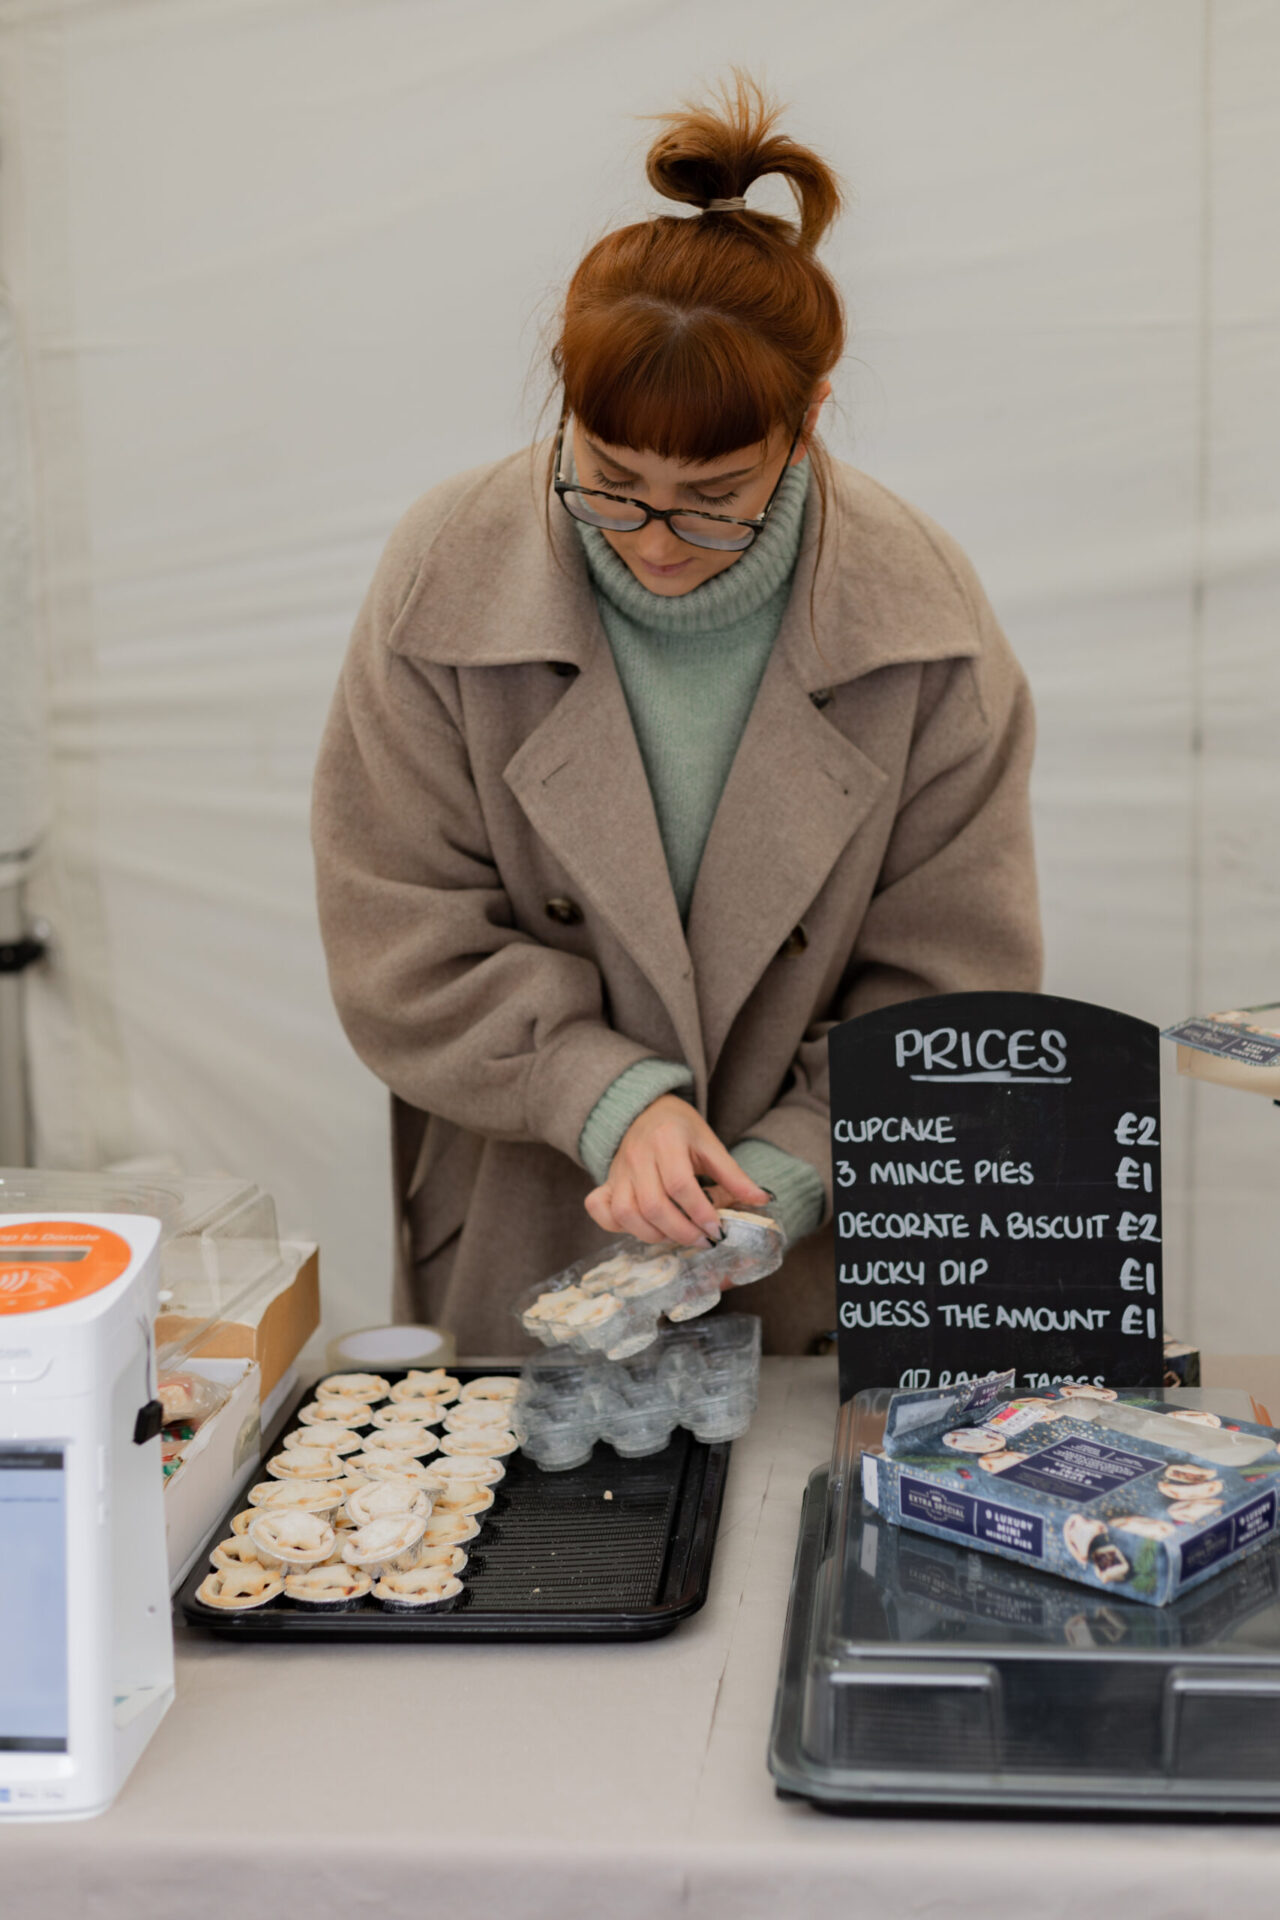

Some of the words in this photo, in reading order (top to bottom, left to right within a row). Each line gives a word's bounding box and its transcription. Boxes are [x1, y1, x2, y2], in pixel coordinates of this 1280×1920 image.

[895, 1027, 1067, 1073] PRICES
[834, 1116, 956, 1143] CUPCAKE
[1114, 1112, 1160, 1145] £2
[836, 1160, 857, 1187] 3
[871, 1160, 964, 1185] MINCE
[975, 1160, 1034, 1185] PIES
[1115, 1156, 1153, 1192] £1
[838, 1211, 970, 1239] DECORATE
[980, 1214, 1000, 1238] A
[1007, 1211, 1110, 1240] BISCUIT
[1116, 1211, 1162, 1242] £2
[839, 1260, 925, 1285] LUCKY
[940, 1258, 988, 1285] DIP
[1119, 1258, 1156, 1295] £1
[839, 1300, 931, 1329] GUESS
[937, 1304, 992, 1329] THE
[995, 1306, 1112, 1332] AMOUNT
[1121, 1304, 1157, 1339] £1
[994, 1512, 1034, 1532] LUXURY
